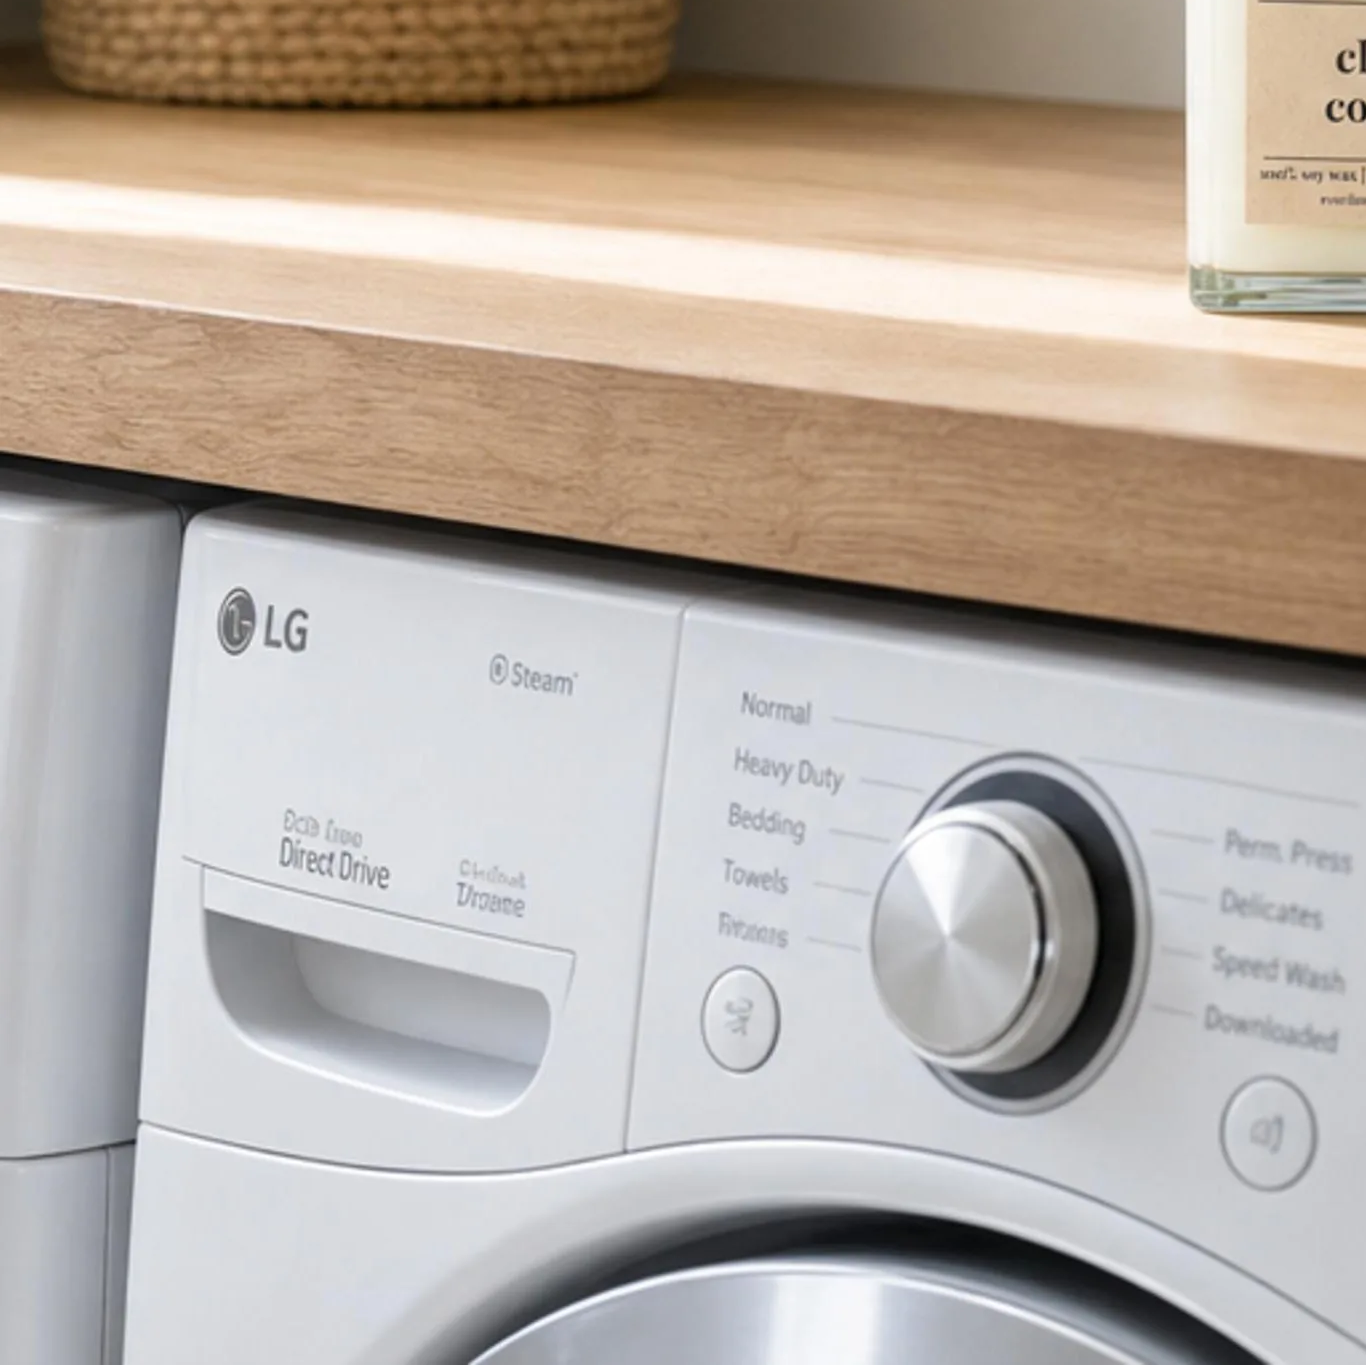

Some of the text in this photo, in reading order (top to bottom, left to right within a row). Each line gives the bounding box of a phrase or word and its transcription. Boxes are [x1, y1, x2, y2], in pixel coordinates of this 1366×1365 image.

[263, 604, 310, 653] LG
[511, 662, 575, 697] Steam
[740, 690, 812, 726] Normal
[734, 747, 845, 796] Heavy Duty
[728, 802, 806, 844] Bedding
[279, 836, 391, 891] Direct Drive
[1224, 828, 1354, 875] Perm. Press
[722, 858, 789, 896] Towels
[1220, 888, 1324, 931] Delicates
[1211, 947, 1347, 997] Speed Wash
[1204, 1003, 1339, 1055] Downloaded
